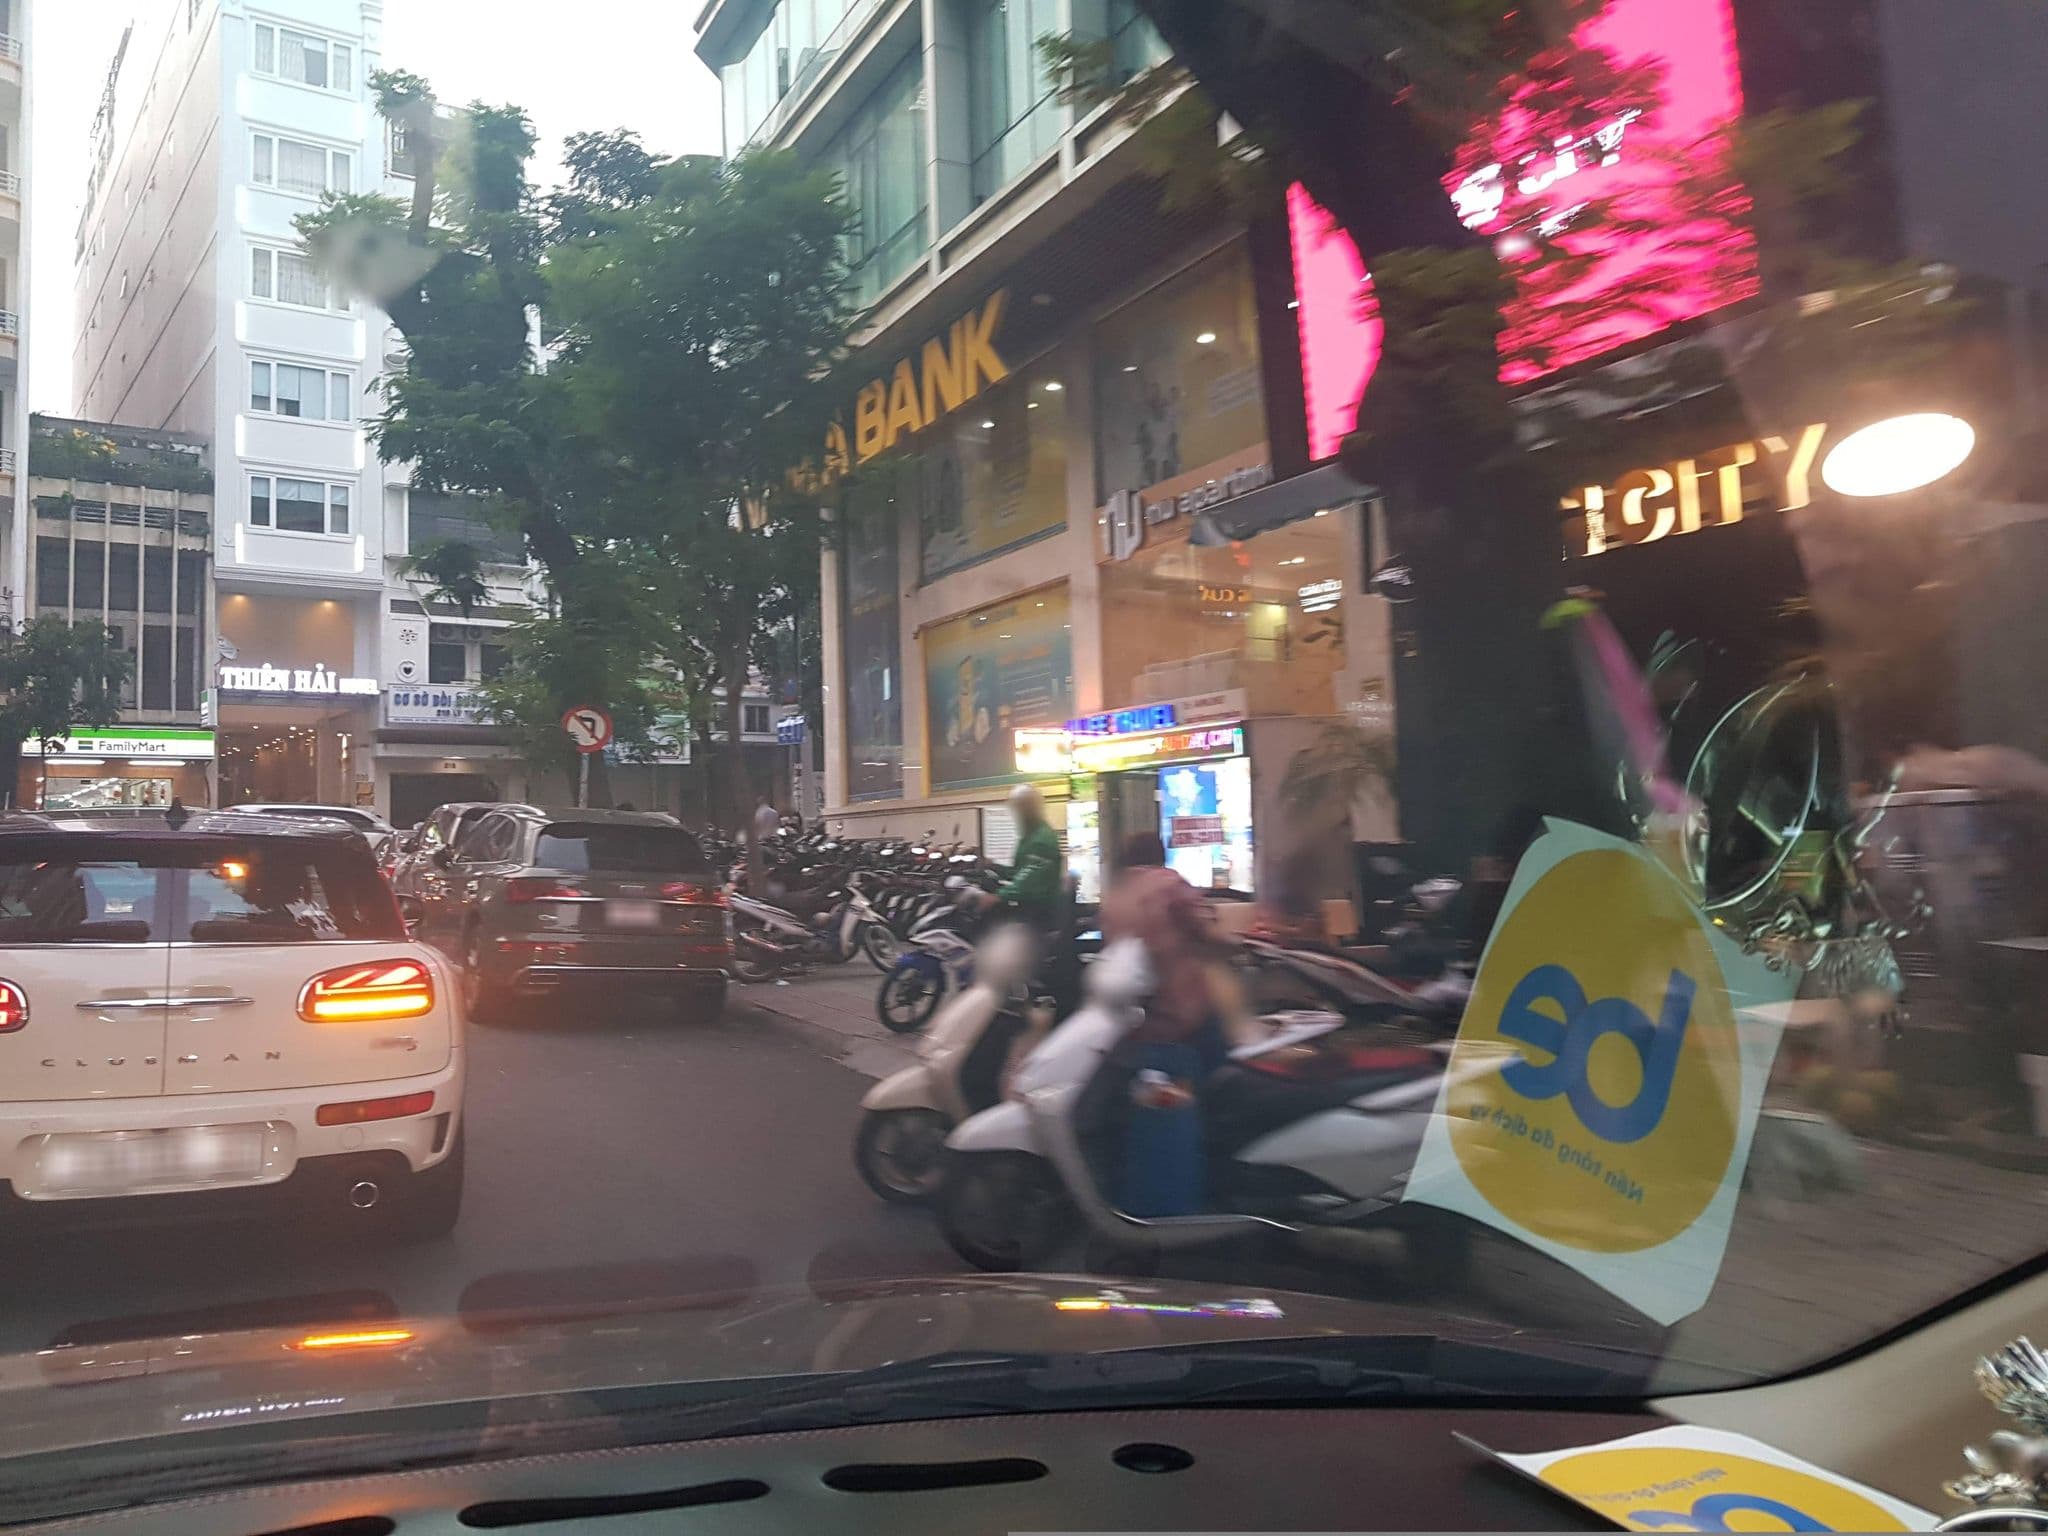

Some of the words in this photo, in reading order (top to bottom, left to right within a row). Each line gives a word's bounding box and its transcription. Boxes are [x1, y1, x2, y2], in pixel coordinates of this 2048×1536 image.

[856, 288, 1009, 464] BANK
[219, 662, 291, 691] THIÊN
[293, 662, 337, 693] HẢI
[99, 741, 166, 753] FamilyMart
[40, 1051, 281, 1067] CLUBMAN
